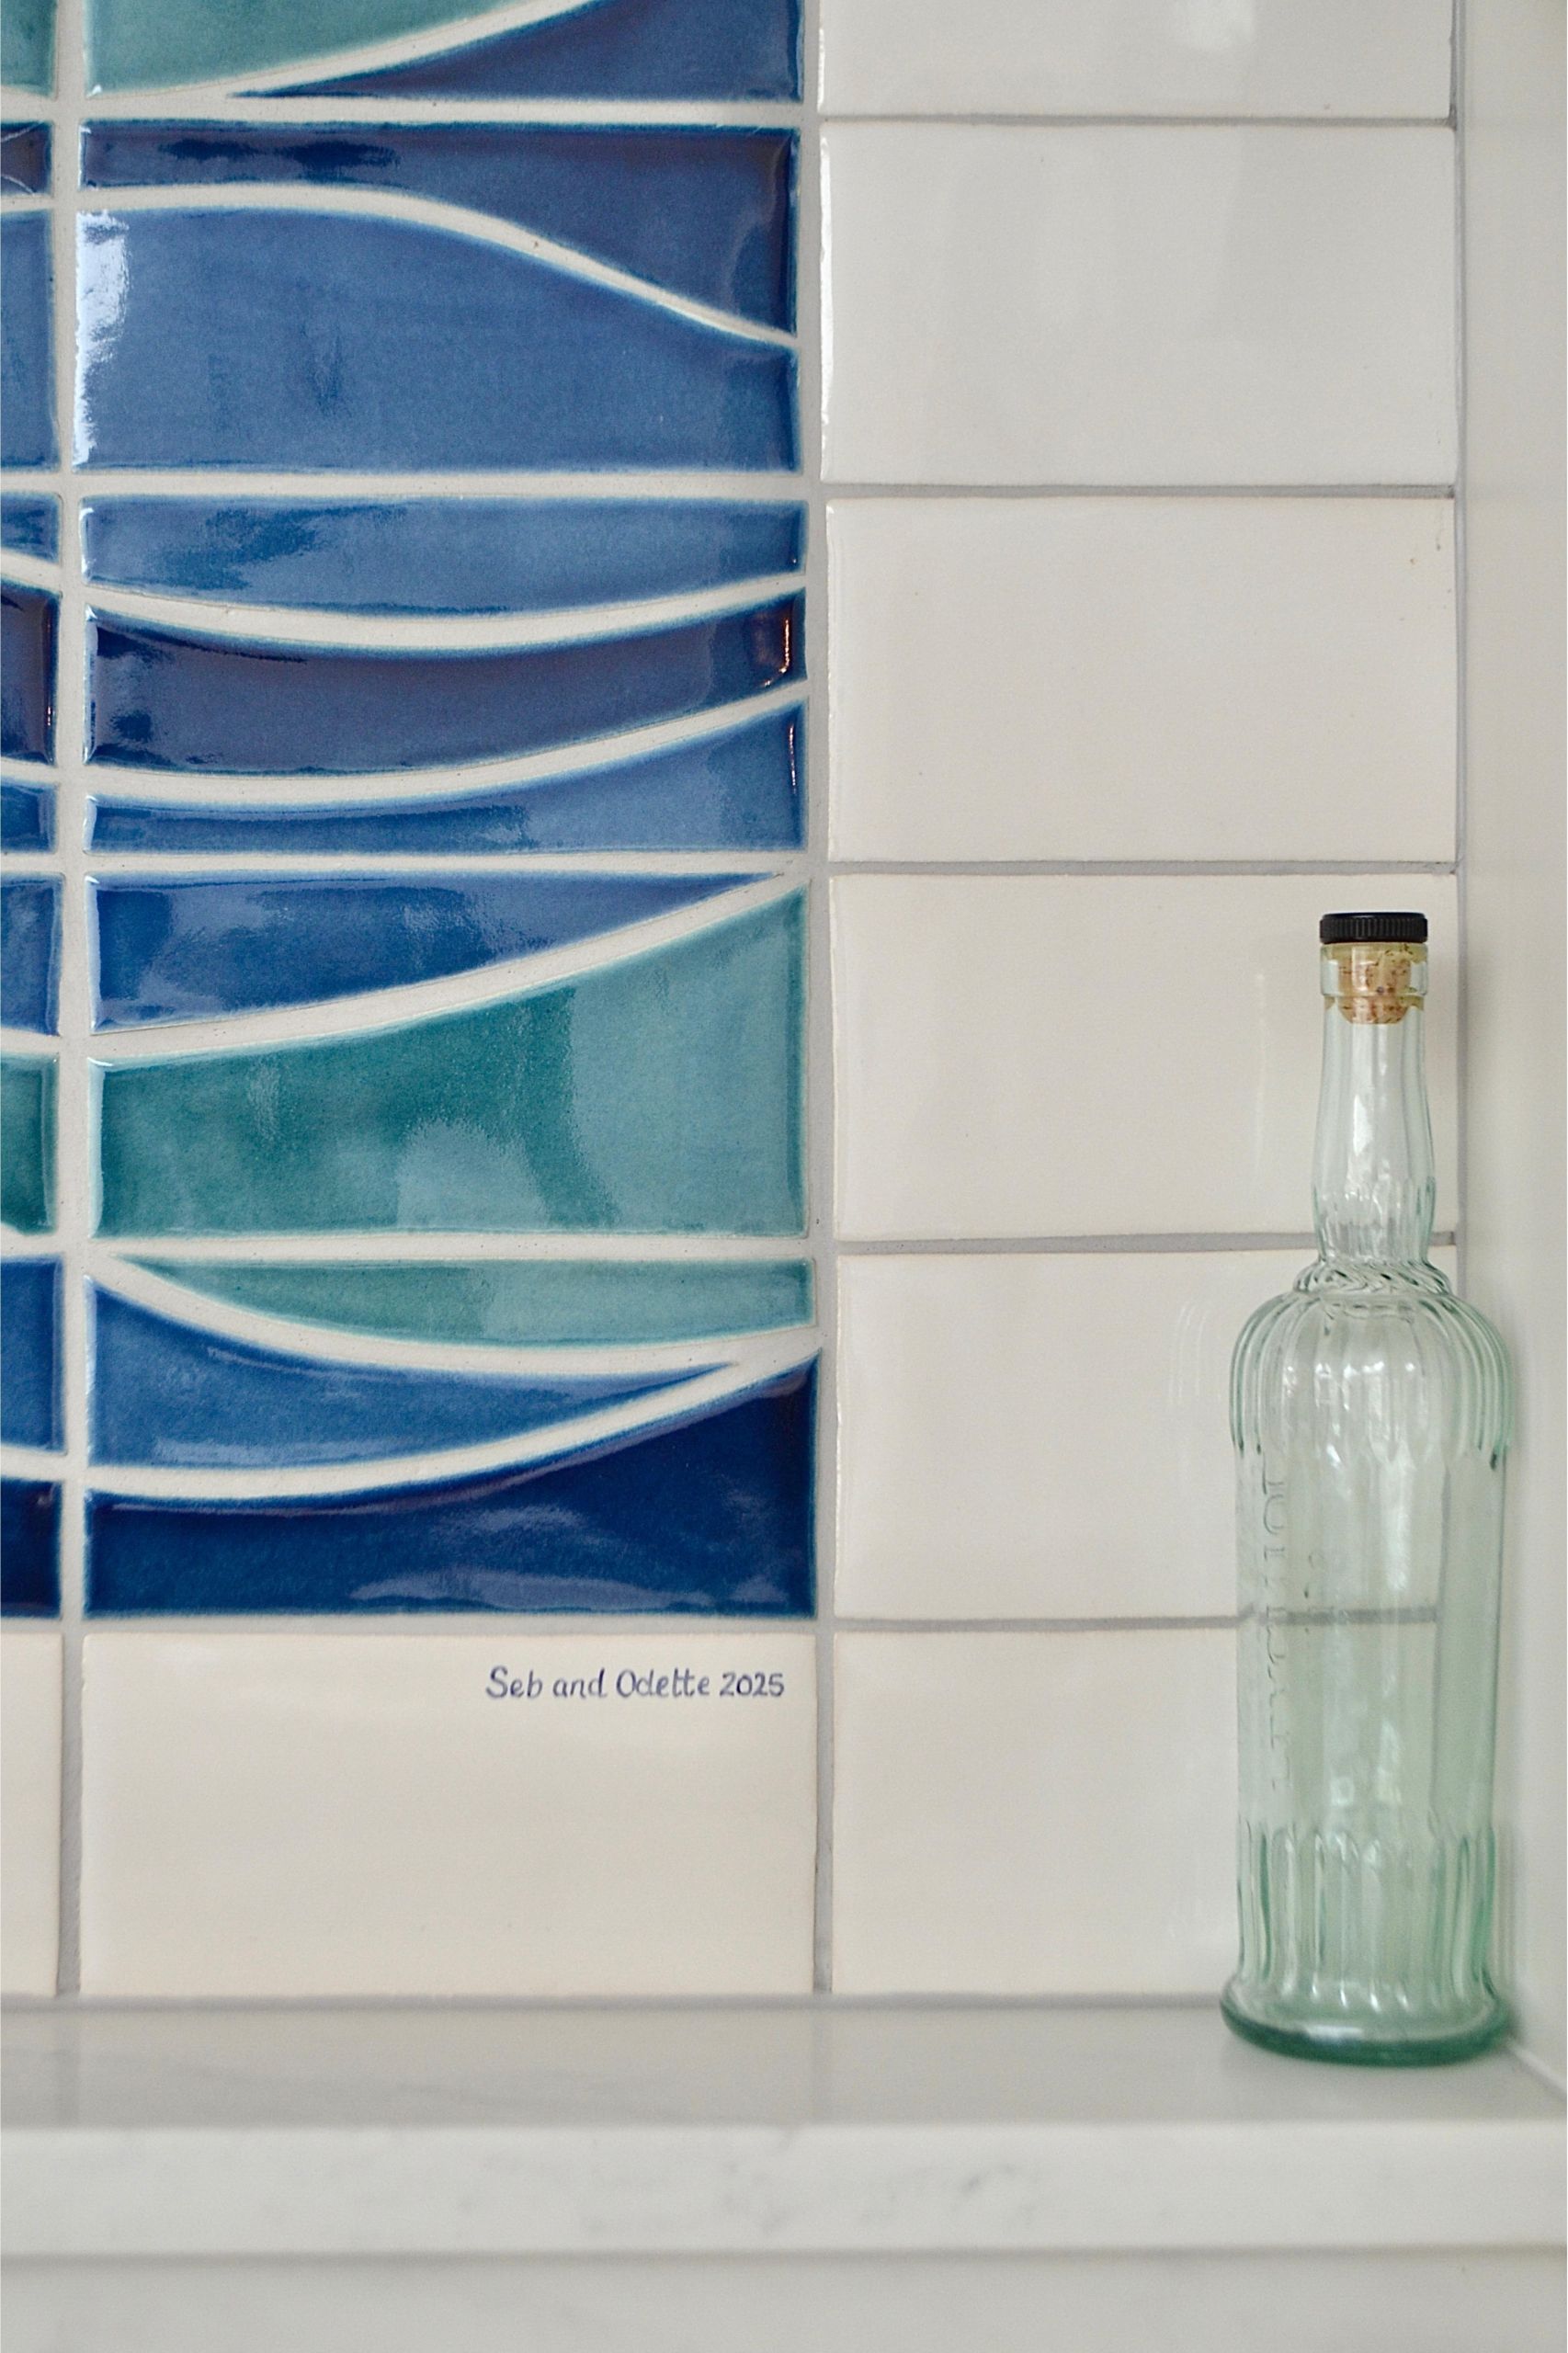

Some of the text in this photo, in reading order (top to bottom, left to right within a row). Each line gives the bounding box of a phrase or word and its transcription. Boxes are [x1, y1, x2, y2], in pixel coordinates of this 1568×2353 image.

[485, 1665, 785, 1699] Seb and Odette 2025
